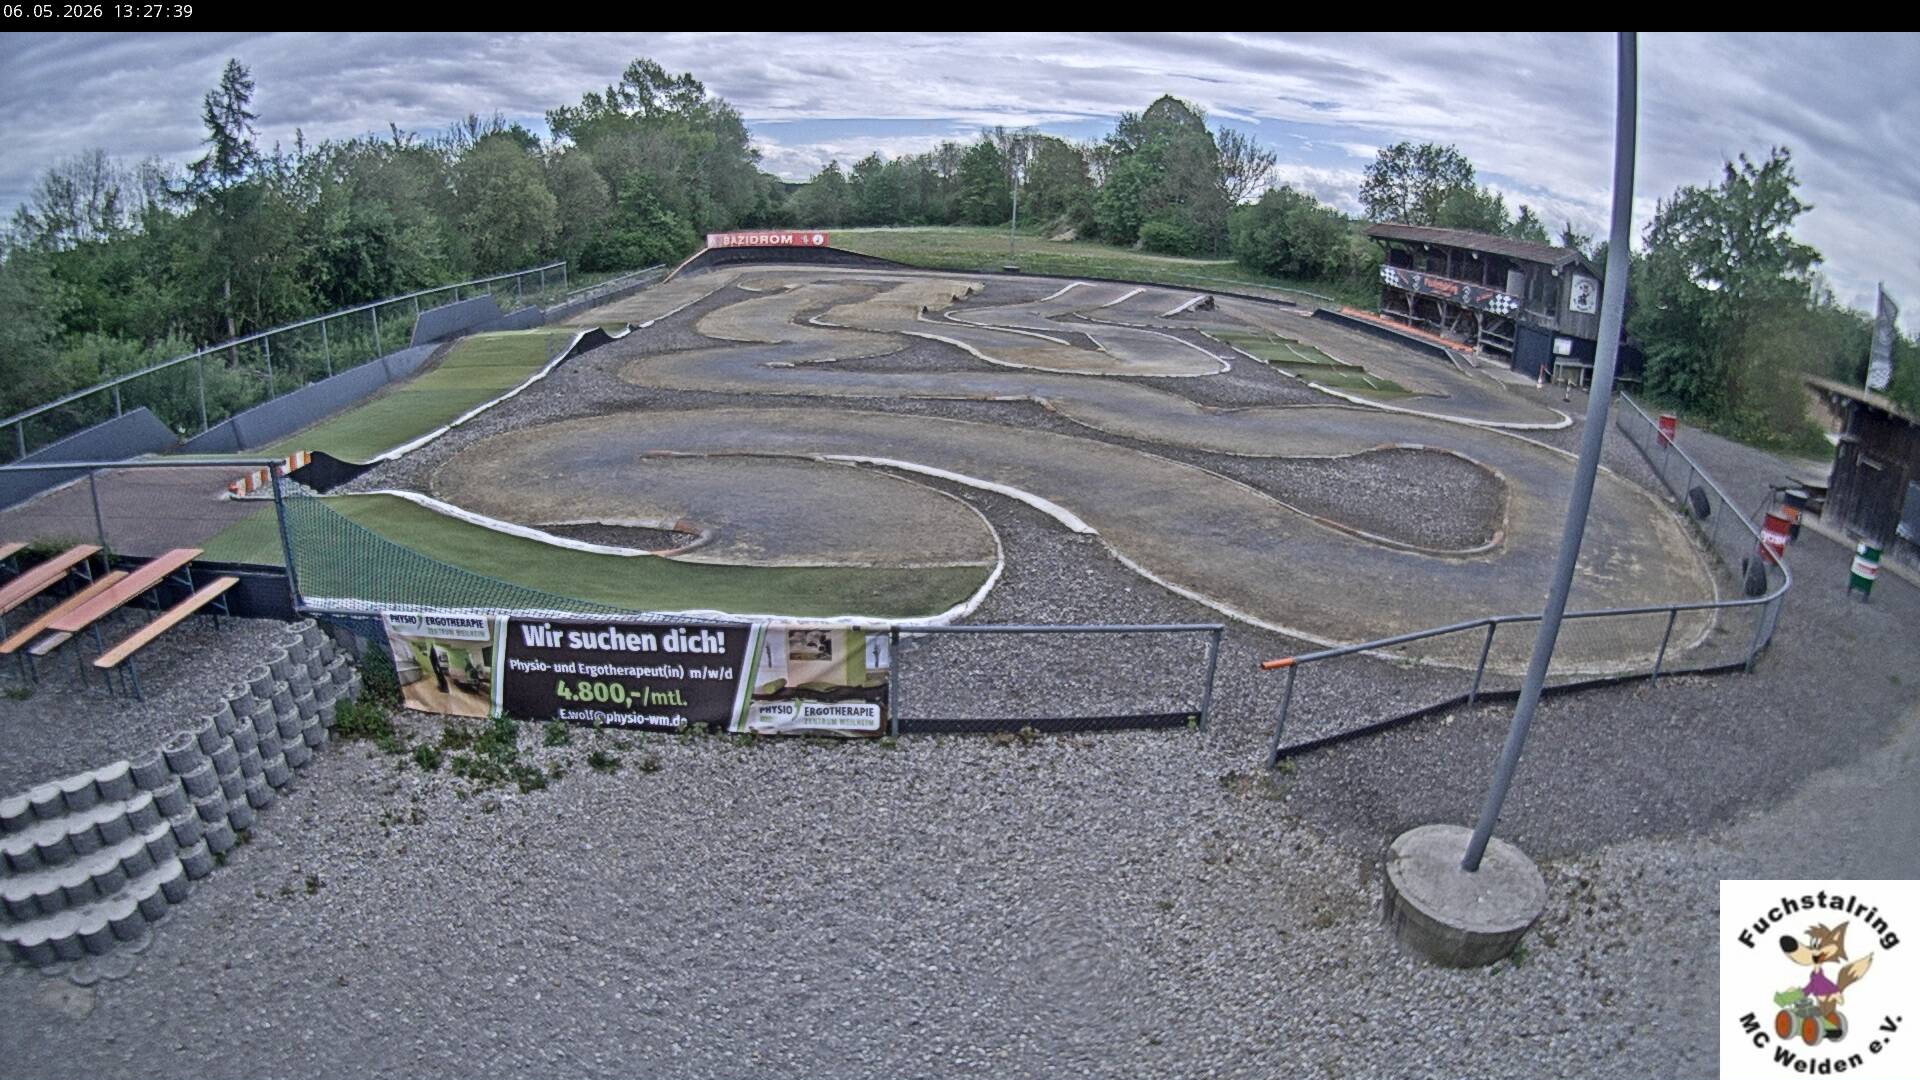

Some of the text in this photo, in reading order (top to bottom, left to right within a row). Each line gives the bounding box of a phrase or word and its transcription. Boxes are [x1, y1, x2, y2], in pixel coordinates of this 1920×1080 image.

[723, 234, 793, 246] BAZIDROM
[389, 613, 484, 629] PHYSIO ERGOTHERAPIE
[521, 623, 726, 654] Wir suchen dich!
[509, 658, 734, 680] Physio- und Ergotherapeut(in) m/w/d
[759, 705, 875, 718] PHYSIO ERGOTHERAPIE
